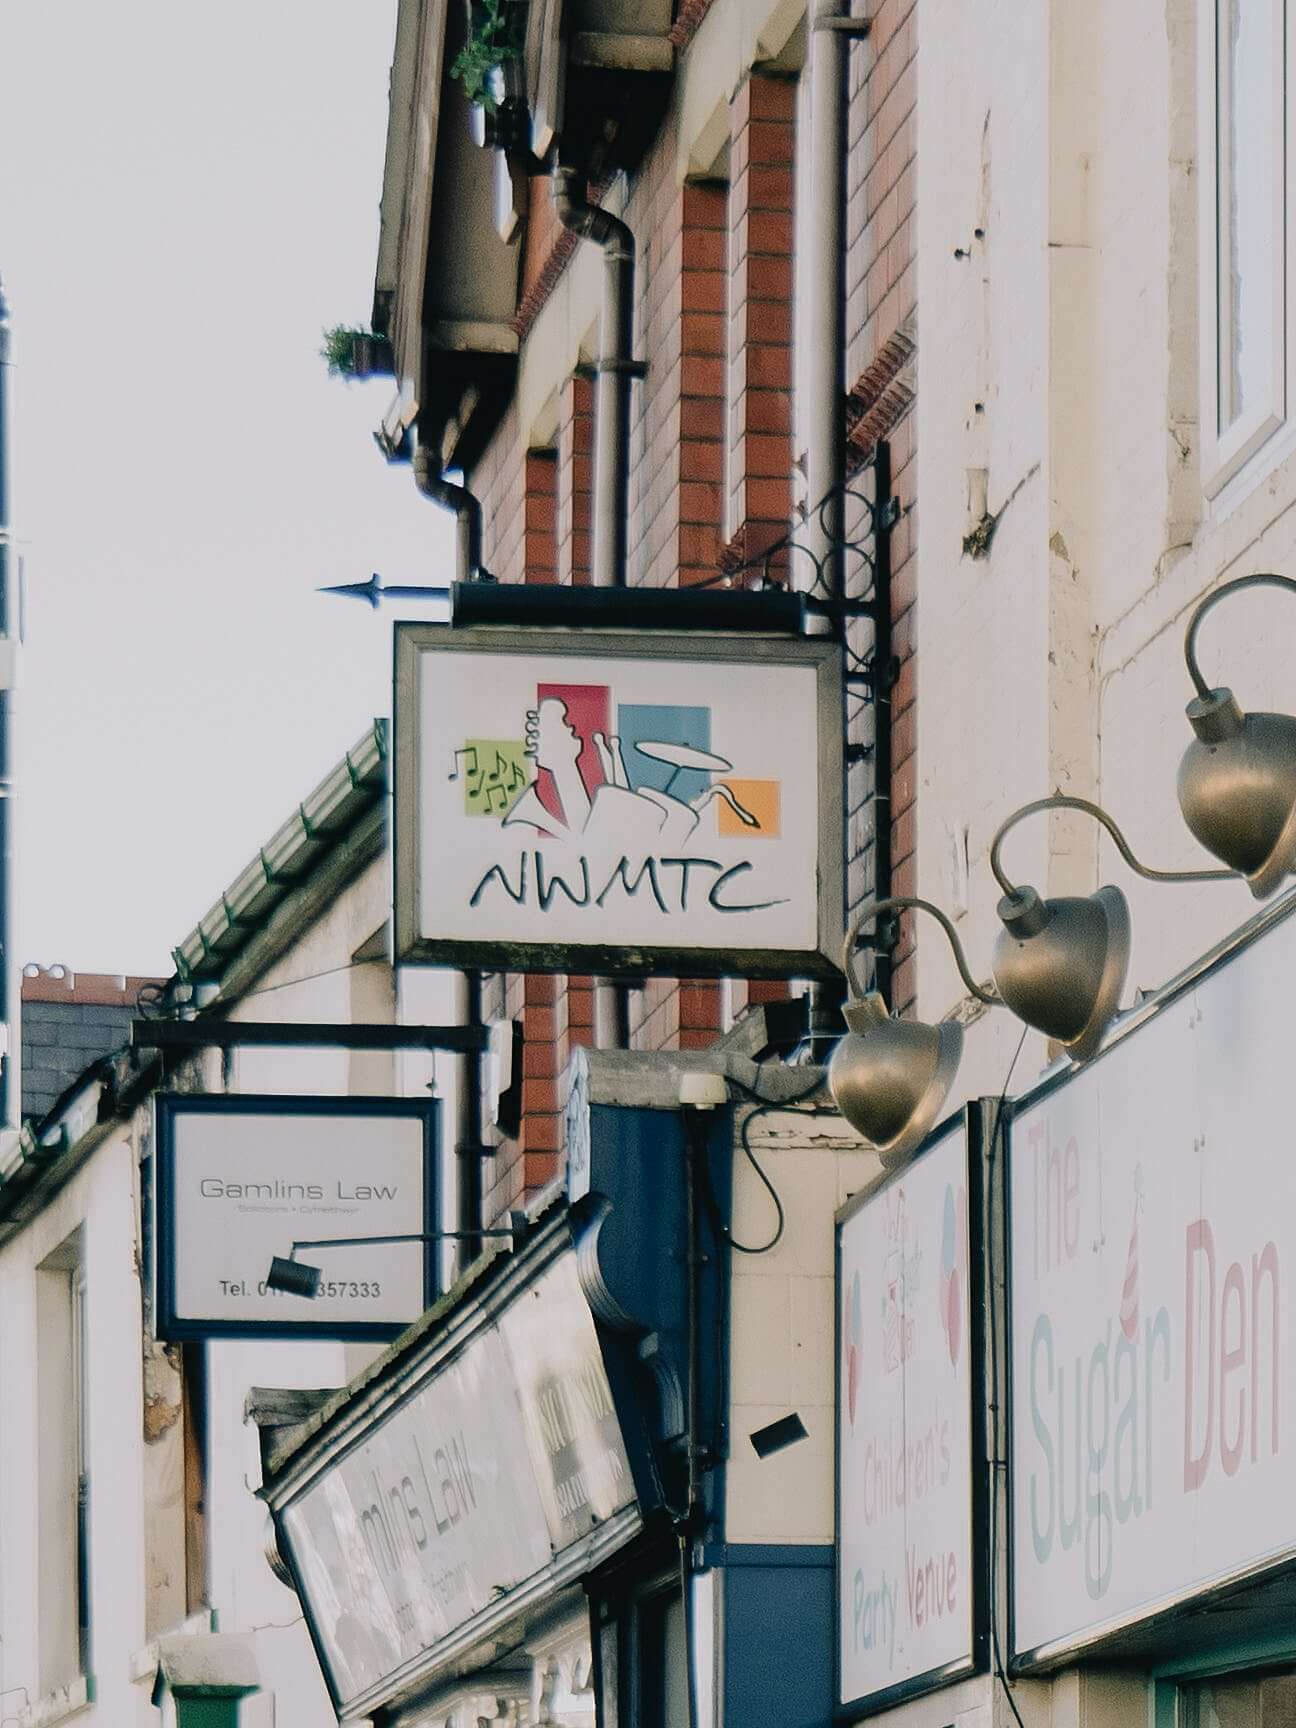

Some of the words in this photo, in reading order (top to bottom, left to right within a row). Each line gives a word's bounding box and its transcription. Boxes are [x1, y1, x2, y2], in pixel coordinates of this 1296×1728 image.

[469, 851, 791, 914] NWMTC
[200, 1179, 323, 1200] Gamlins
[337, 1180, 398, 1201] Law
[1028, 1115, 1081, 1280] The
[219, 1280, 251, 1298] Tel.
[864, 1399, 952, 1527] Children's
[1028, 1304, 1171, 1601] Sugar
[1183, 1217, 1280, 1494] Den
[360, 1466, 428, 1576] mlins
[412, 1428, 478, 1537] Law
[853, 1564, 898, 1672] Party
[905, 1550, 958, 1629] Venue
